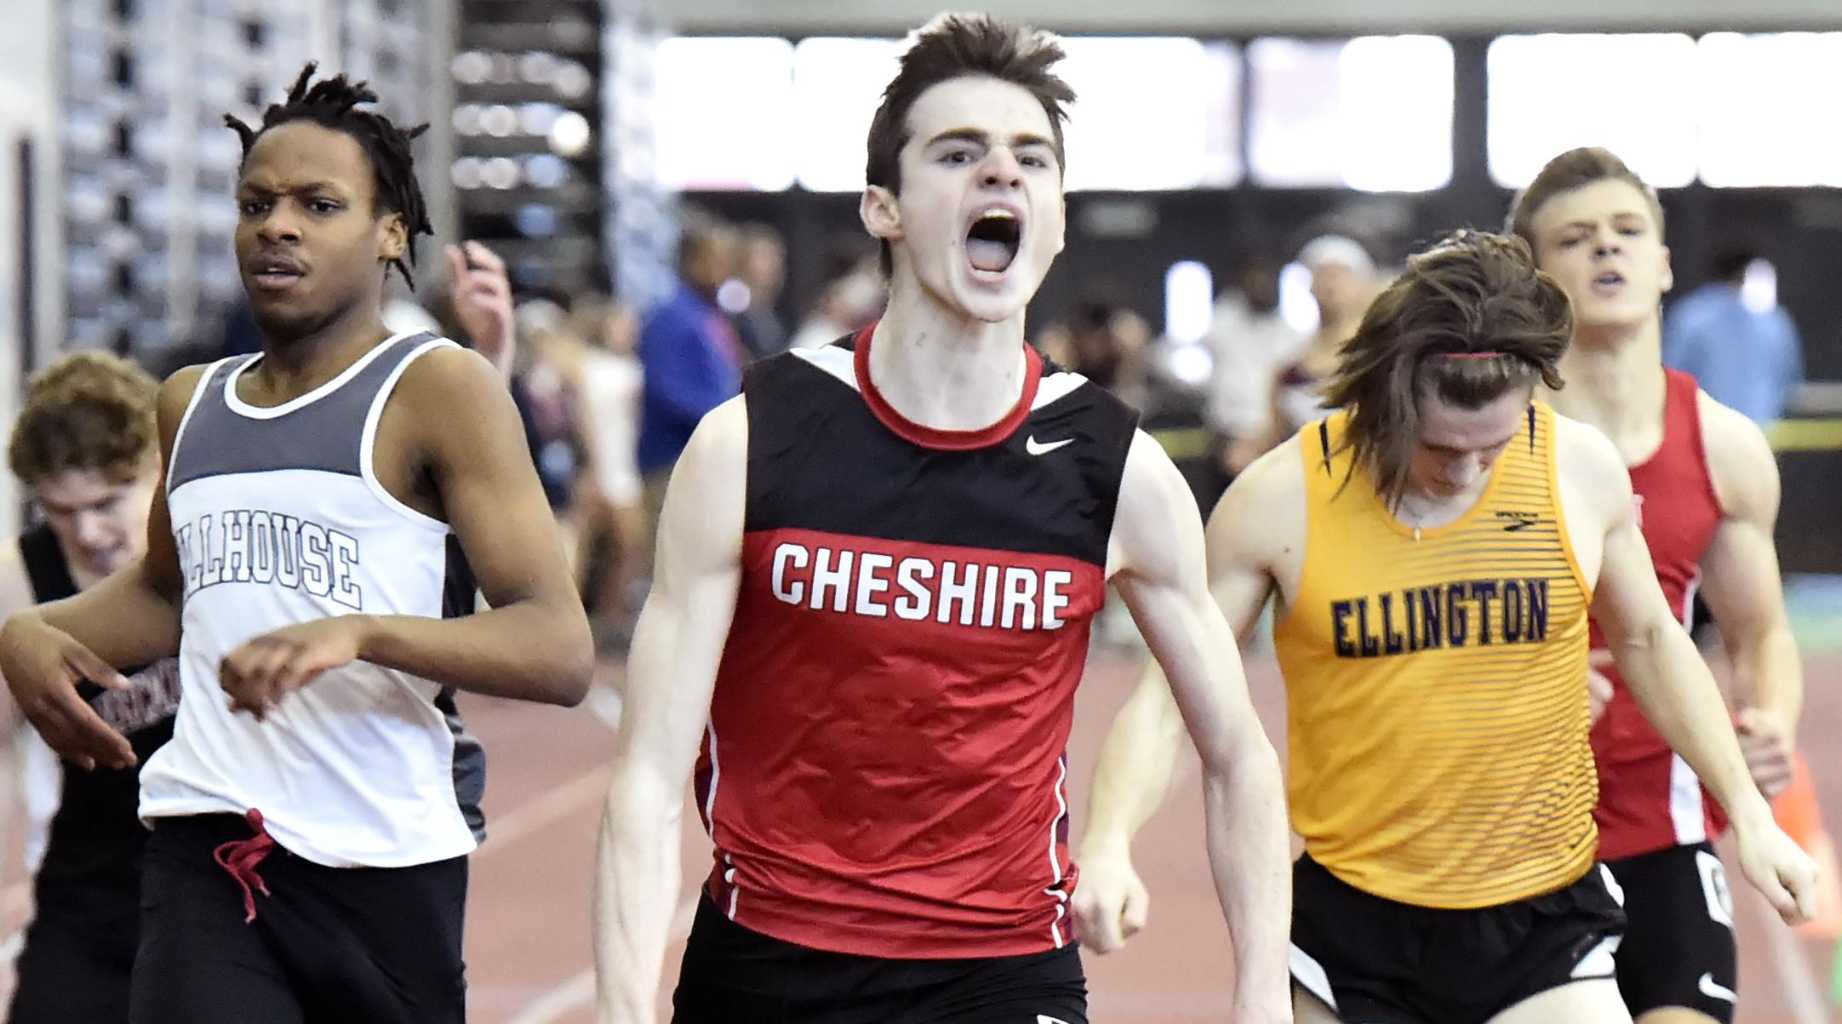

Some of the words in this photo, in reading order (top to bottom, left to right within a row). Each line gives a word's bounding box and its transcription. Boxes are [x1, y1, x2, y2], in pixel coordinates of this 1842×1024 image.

[176, 509, 362, 611] LLHOUSE
[771, 542, 1072, 631] CHESHIRE
[1331, 577, 1549, 658] ELLINGTON
